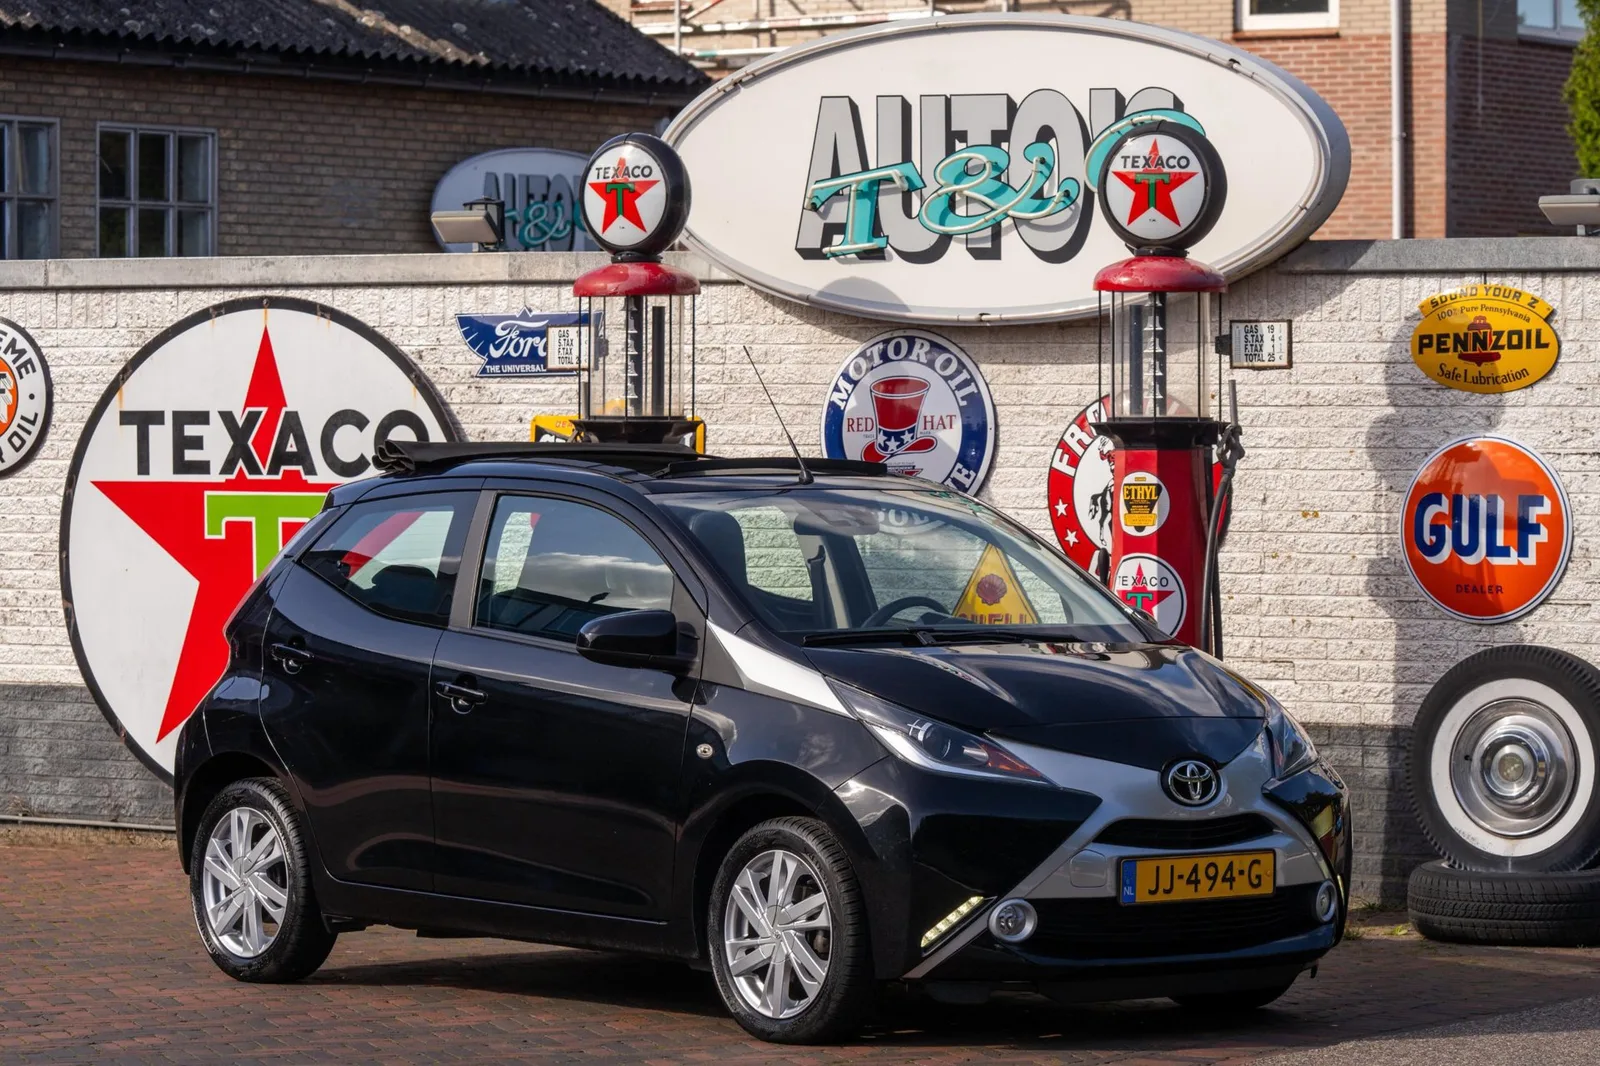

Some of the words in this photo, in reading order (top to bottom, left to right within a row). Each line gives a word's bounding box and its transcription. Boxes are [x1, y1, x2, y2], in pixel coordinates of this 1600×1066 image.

[1121, 155, 1190, 169] TEXACO
[595, 165, 653, 180] TEXACO
[606, 182, 636, 217] T
[1134, 172, 1171, 210] T
[1484, 286, 1522, 302] YOUR
[1527, 297, 1540, 309] Z
[1460, 304, 1479, 314] Pure
[1480, 304, 1531, 323] Pennsylvania
[557, 329, 570, 339] GAS
[1243, 324, 1259, 334] GAS
[1266, 324, 1275, 334] 19
[489, 319, 549, 359] For
[1243, 334, 1265, 344] S.TAX
[1270, 334, 1275, 344] 4
[1418, 328, 1550, 355] PENNZOIL
[1244, 343, 1264, 353] F.TAX
[557, 356, 574, 365] TOTAL
[1244, 353, 1266, 363] TOTAL
[1267, 353, 1276, 363] 25
[485, 365, 501, 373] THE
[501, 364, 547, 373] UNIVERSAL
[830, 337, 931, 411] MOTOR
[934, 352, 979, 407] OIL
[1437, 362, 1462, 382] Safe
[1464, 367, 1530, 385] Lubrication
[846, 417, 875, 433] RED
[922, 414, 957, 431] HAT
[7, 412, 39, 453] OIL
[1123, 485, 1158, 500] ETHYL
[1414, 492, 1551, 566] GULF
[1455, 583, 1504, 595] DEALER
[1147, 858, 1262, 896] JJ-494-G
[1123, 886, 1134, 896] NL
